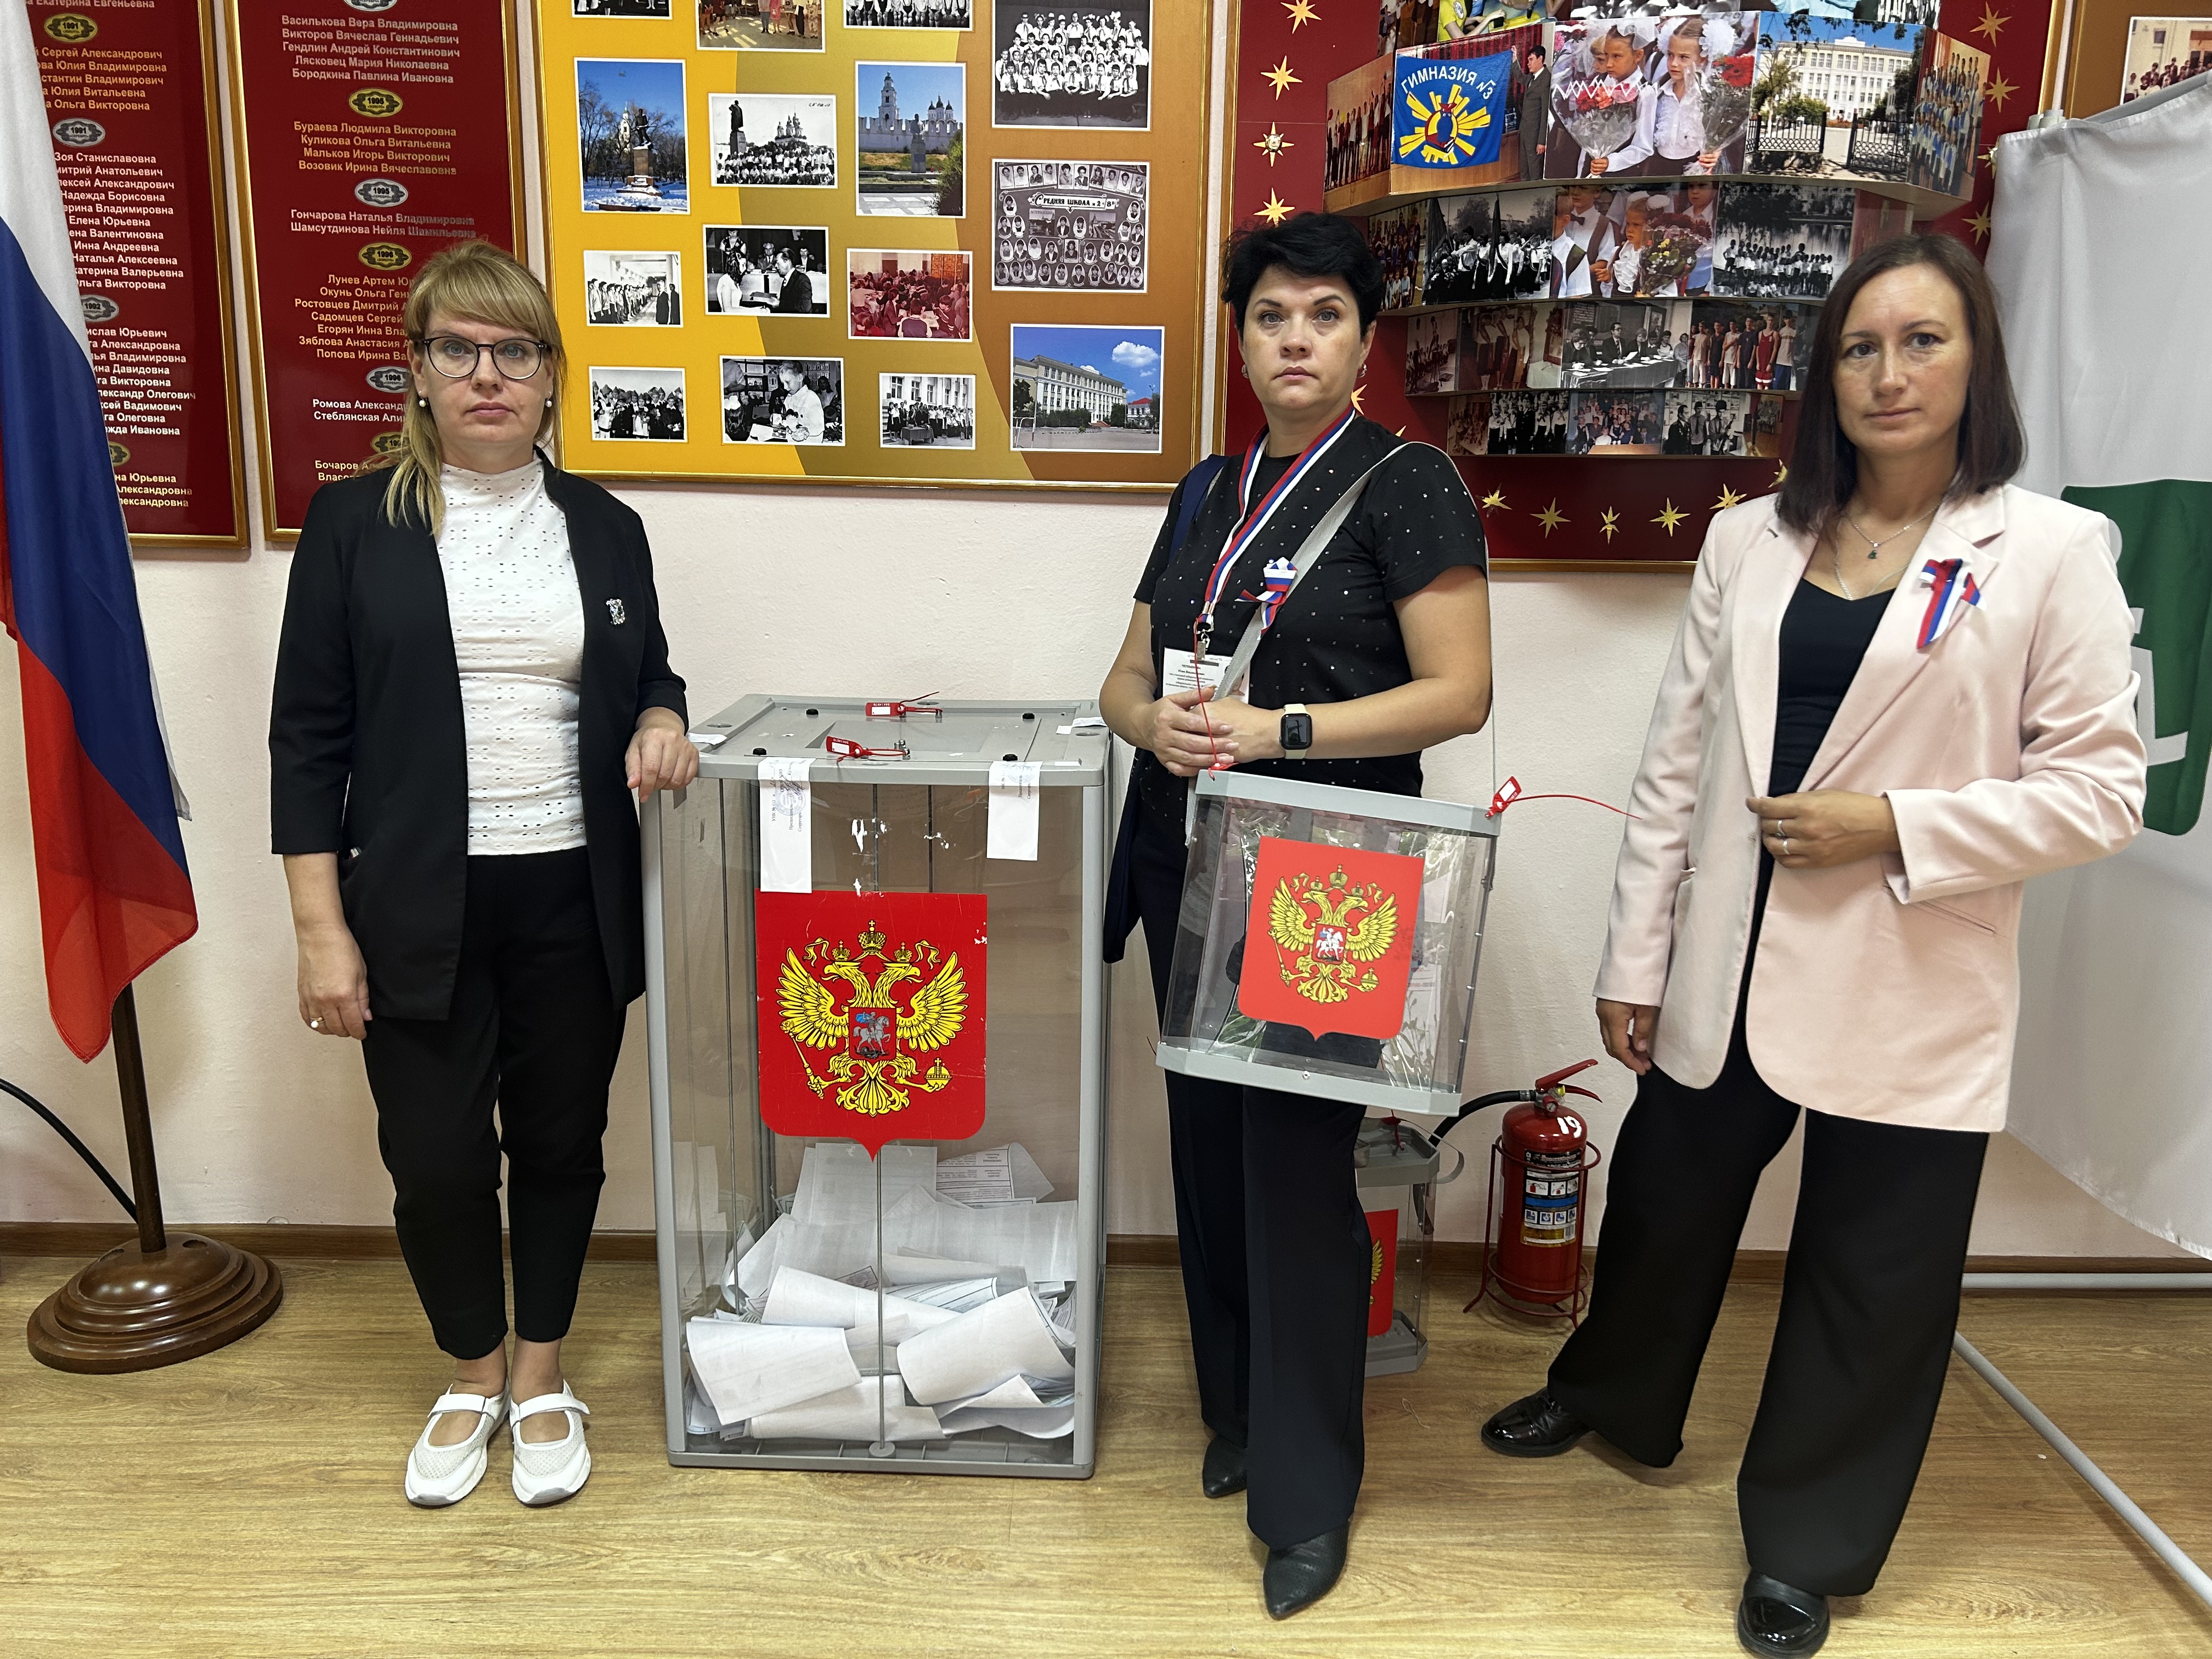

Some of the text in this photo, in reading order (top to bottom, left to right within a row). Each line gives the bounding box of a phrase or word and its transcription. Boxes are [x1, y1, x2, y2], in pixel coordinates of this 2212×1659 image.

[282, 15, 458, 32] Василькова Вера Владимировна
[282, 29, 459, 44] Викторов Вячеслав Геннадьевич
[42, 47, 78, 59] Сергей
[81, 48, 162, 60] Александрович
[283, 41, 460, 57] Гендлин Андрей Константинович
[56, 60, 86, 70] Юлия
[88, 61, 167, 73] Владимировна
[295, 55, 449, 70] Лясковец Мария Николаевна
[42, 74, 163, 86] стантин Владимирович
[292, 68, 454, 83] Бородкина Павлина Ивановна
[1401, 66, 1477, 94] ГИМНАЗИЯ
[51, 86, 81, 95] Юлия
[83, 87, 145, 97] Витальевна
[54, 99, 86, 109] Ольга
[88, 100, 150, 112] Викторовна
[70, 126, 87, 134] 1991
[294, 121, 456, 137] Бураева Людмила Викторовна
[301, 134, 450, 149] Куликова Ольга Витальевна
[54, 152, 156, 163] Зоя Станиславовна
[304, 147, 450, 163] Мальков Игорь Викторович
[55, 165, 162, 176] митрий Анатольевич
[299, 160, 456, 174] Возовик Ирина Вячеславовна
[58, 177, 174, 190] лексей Александрович
[61, 190, 165, 202] Надежда Борисовна
[1035, 194, 1065, 206] СРЕДНЯЯ
[64, 204, 173, 216] ерина Владимировна
[69, 216, 150, 228] Елена Юрьевна
[291, 209, 474, 226] Гончарова Наталья Владимировна
[90, 229, 163, 239] Валентиновна
[291, 222, 370, 234] Шамсутдинова
[373, 225, 405, 235] Нейля
[74, 241, 159, 253] Инна Андреевна
[72, 253, 177, 265] Наталья Алексеевна
[122, 267, 183, 279] Валерьевна
[105, 279, 166, 290] Викторовна
[328, 274, 360, 285] Лунев
[363, 276, 394, 287] Артем
[320, 287, 352, 298] Окунь
[355, 288, 386, 297] Ольга
[295, 298, 349, 310] Ростовцев
[353, 301, 398, 312] Дмитрий
[312, 312, 403, 325] Садомцев Сергей
[120, 328, 167, 338] Юрьевич
[318, 324, 353, 335] Егорян
[357, 325, 382, 335] Инна
[101, 340, 180, 352] Александровна
[299, 336, 342, 346] Зяблова
[346, 337, 399, 348] Анастасия
[109, 352, 186, 364] Владимировна
[317, 349, 355, 358] Попова
[358, 350, 390, 361] Ирина
[113, 364, 170, 375] Давидовна
[110, 376, 171, 387] Викторовна
[98, 389, 195, 400] лександр Олегович
[123, 400, 182, 411] Вадимович
[313, 399, 407, 411] Ромова Александ
[117, 413, 166, 422] Олеговна
[314, 411, 405, 423] Стеблянская Али
[130, 425, 180, 435] Ивановна
[315, 460, 359, 471] Бочаров
[129, 473, 176, 483] Юрьевна
[119, 498, 189, 509] лександровна
[1557, 1116, 1582, 1138] 19
